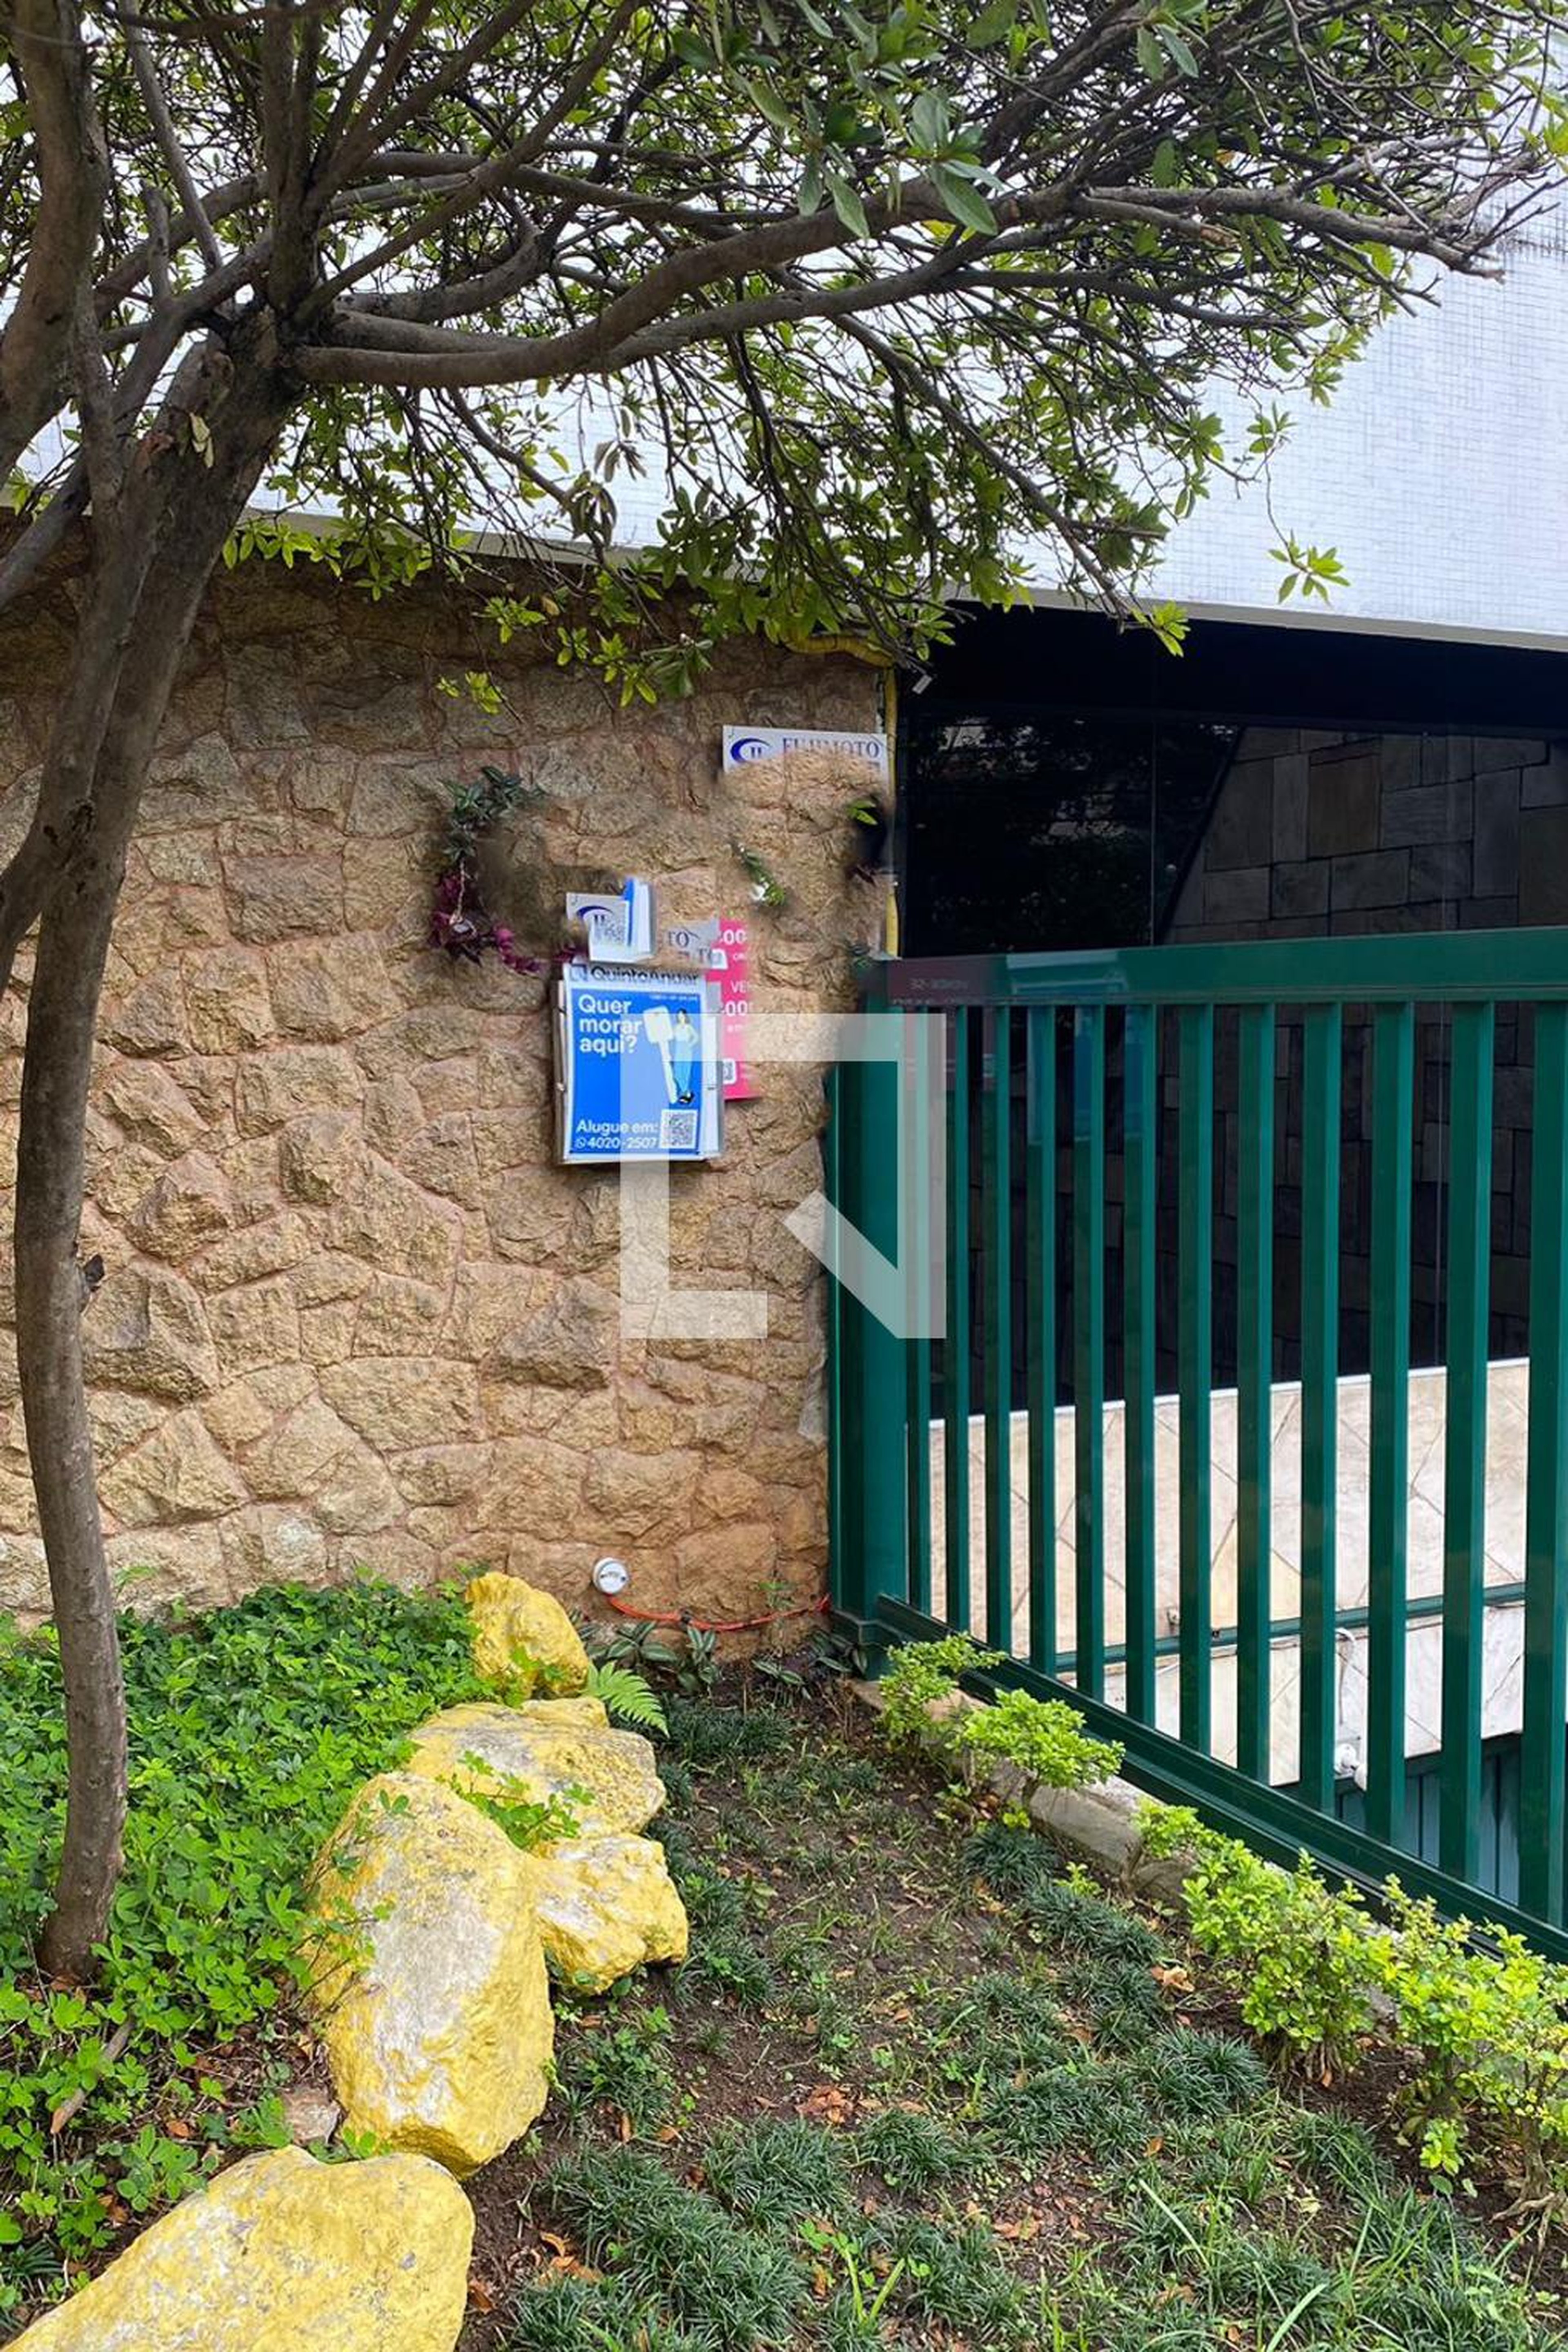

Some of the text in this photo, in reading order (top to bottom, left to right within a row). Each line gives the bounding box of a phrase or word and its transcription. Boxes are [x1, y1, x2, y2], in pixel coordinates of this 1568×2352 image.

[578, 995, 631, 1014] Quer
[579, 1018, 642, 1033] morar
[579, 1036, 637, 1057] aqui?
[576, 1120, 659, 1137] Alugue em:
